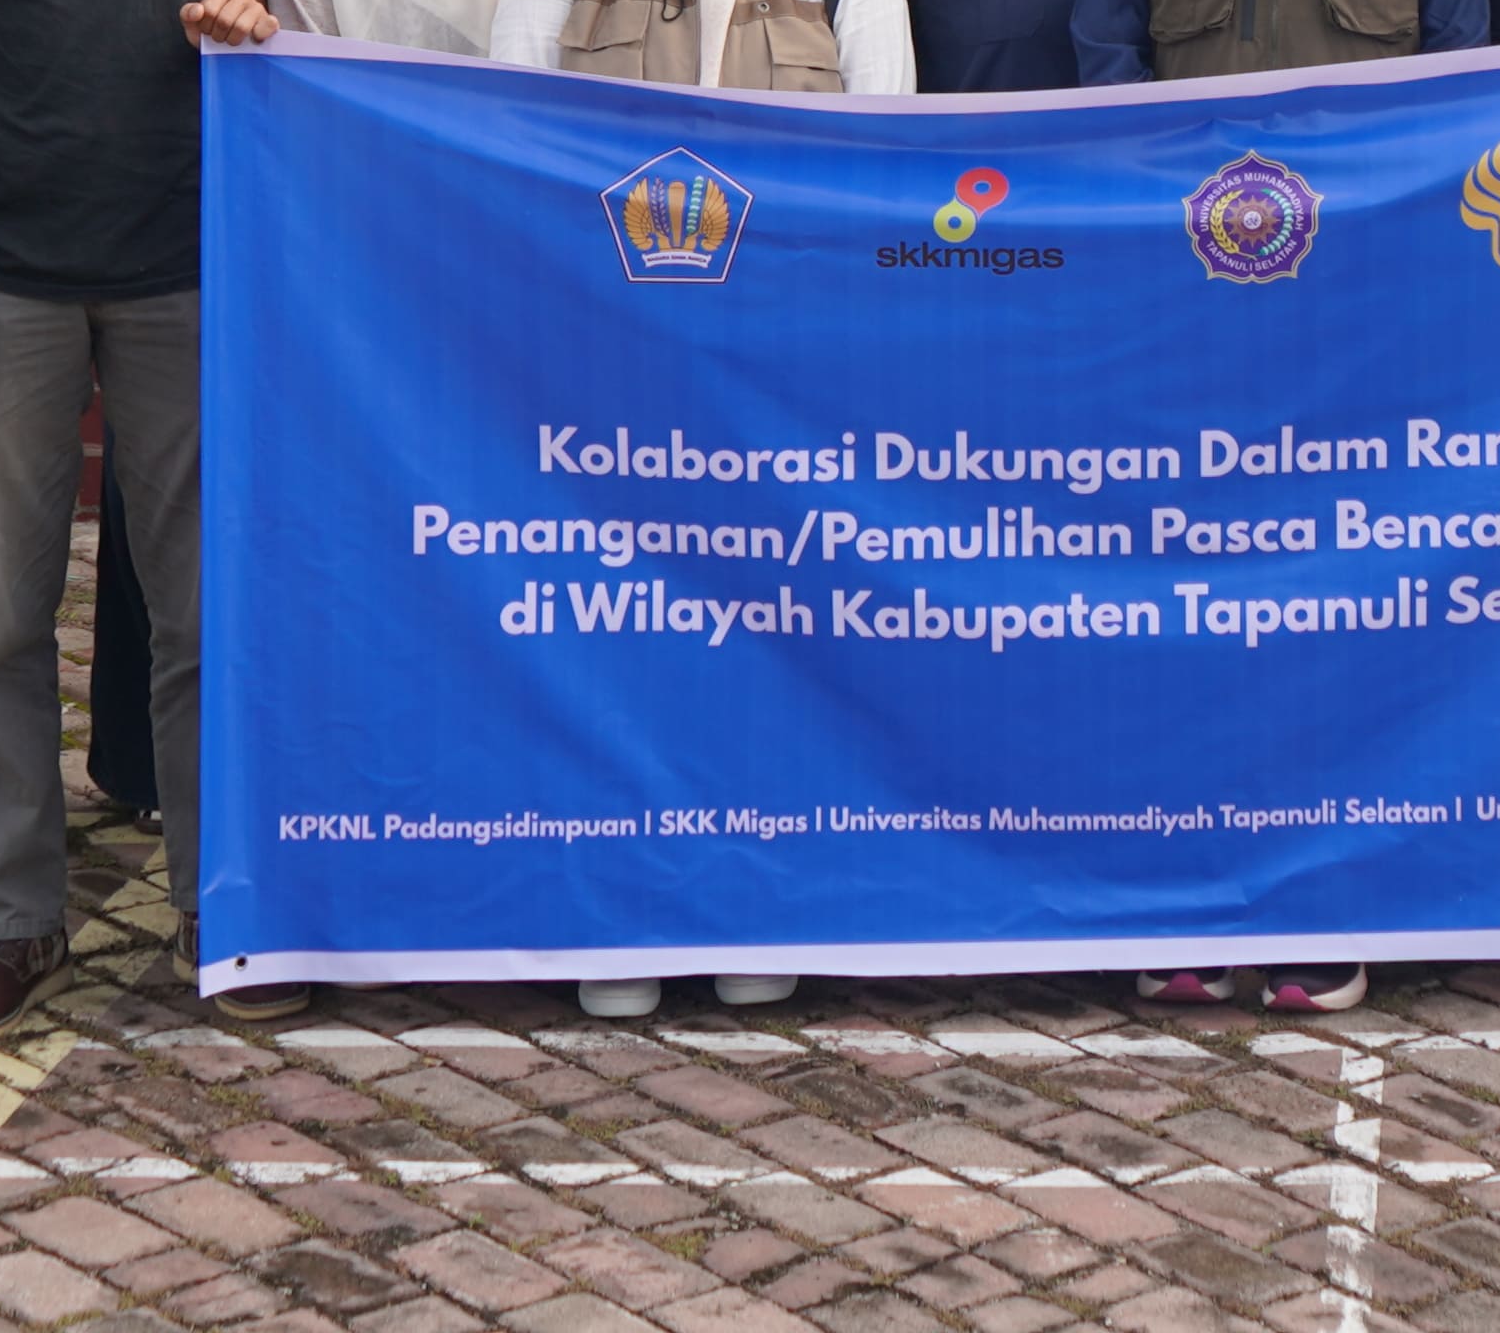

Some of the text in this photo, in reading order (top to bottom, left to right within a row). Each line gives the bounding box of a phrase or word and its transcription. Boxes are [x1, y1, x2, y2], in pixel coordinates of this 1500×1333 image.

[1199, 171, 1305, 233] UNIVERSITAS MUHAMMADIYAH
[875, 240, 1066, 276] skkmigas
[1205, 239, 1298, 272] TAPANULI SELATAN
[538, 424, 856, 483] Kolaborasi
[874, 431, 1181, 495] Dukungan
[1199, 425, 1389, 478] Dalam
[412, 503, 1133, 567] Penanganan/Pemulihan
[1150, 507, 1316, 555] Pasca
[499, 581, 555, 636] di
[566, 579, 814, 647] Wilayah
[832, 587, 1160, 653] Kabupaten
[1173, 577, 1428, 648] Tapanuli
[278, 814, 376, 841] KPKNL
[384, 813, 636, 844] Padangsidimpuan
[658, 808, 719, 835] SKK
[725, 808, 808, 841] Migas
[829, 806, 982, 832] Universitas
[988, 805, 1213, 837] Muhammadiyah
[1219, 800, 1338, 833] Tapanuli
[1344, 797, 1447, 826] Selatan
